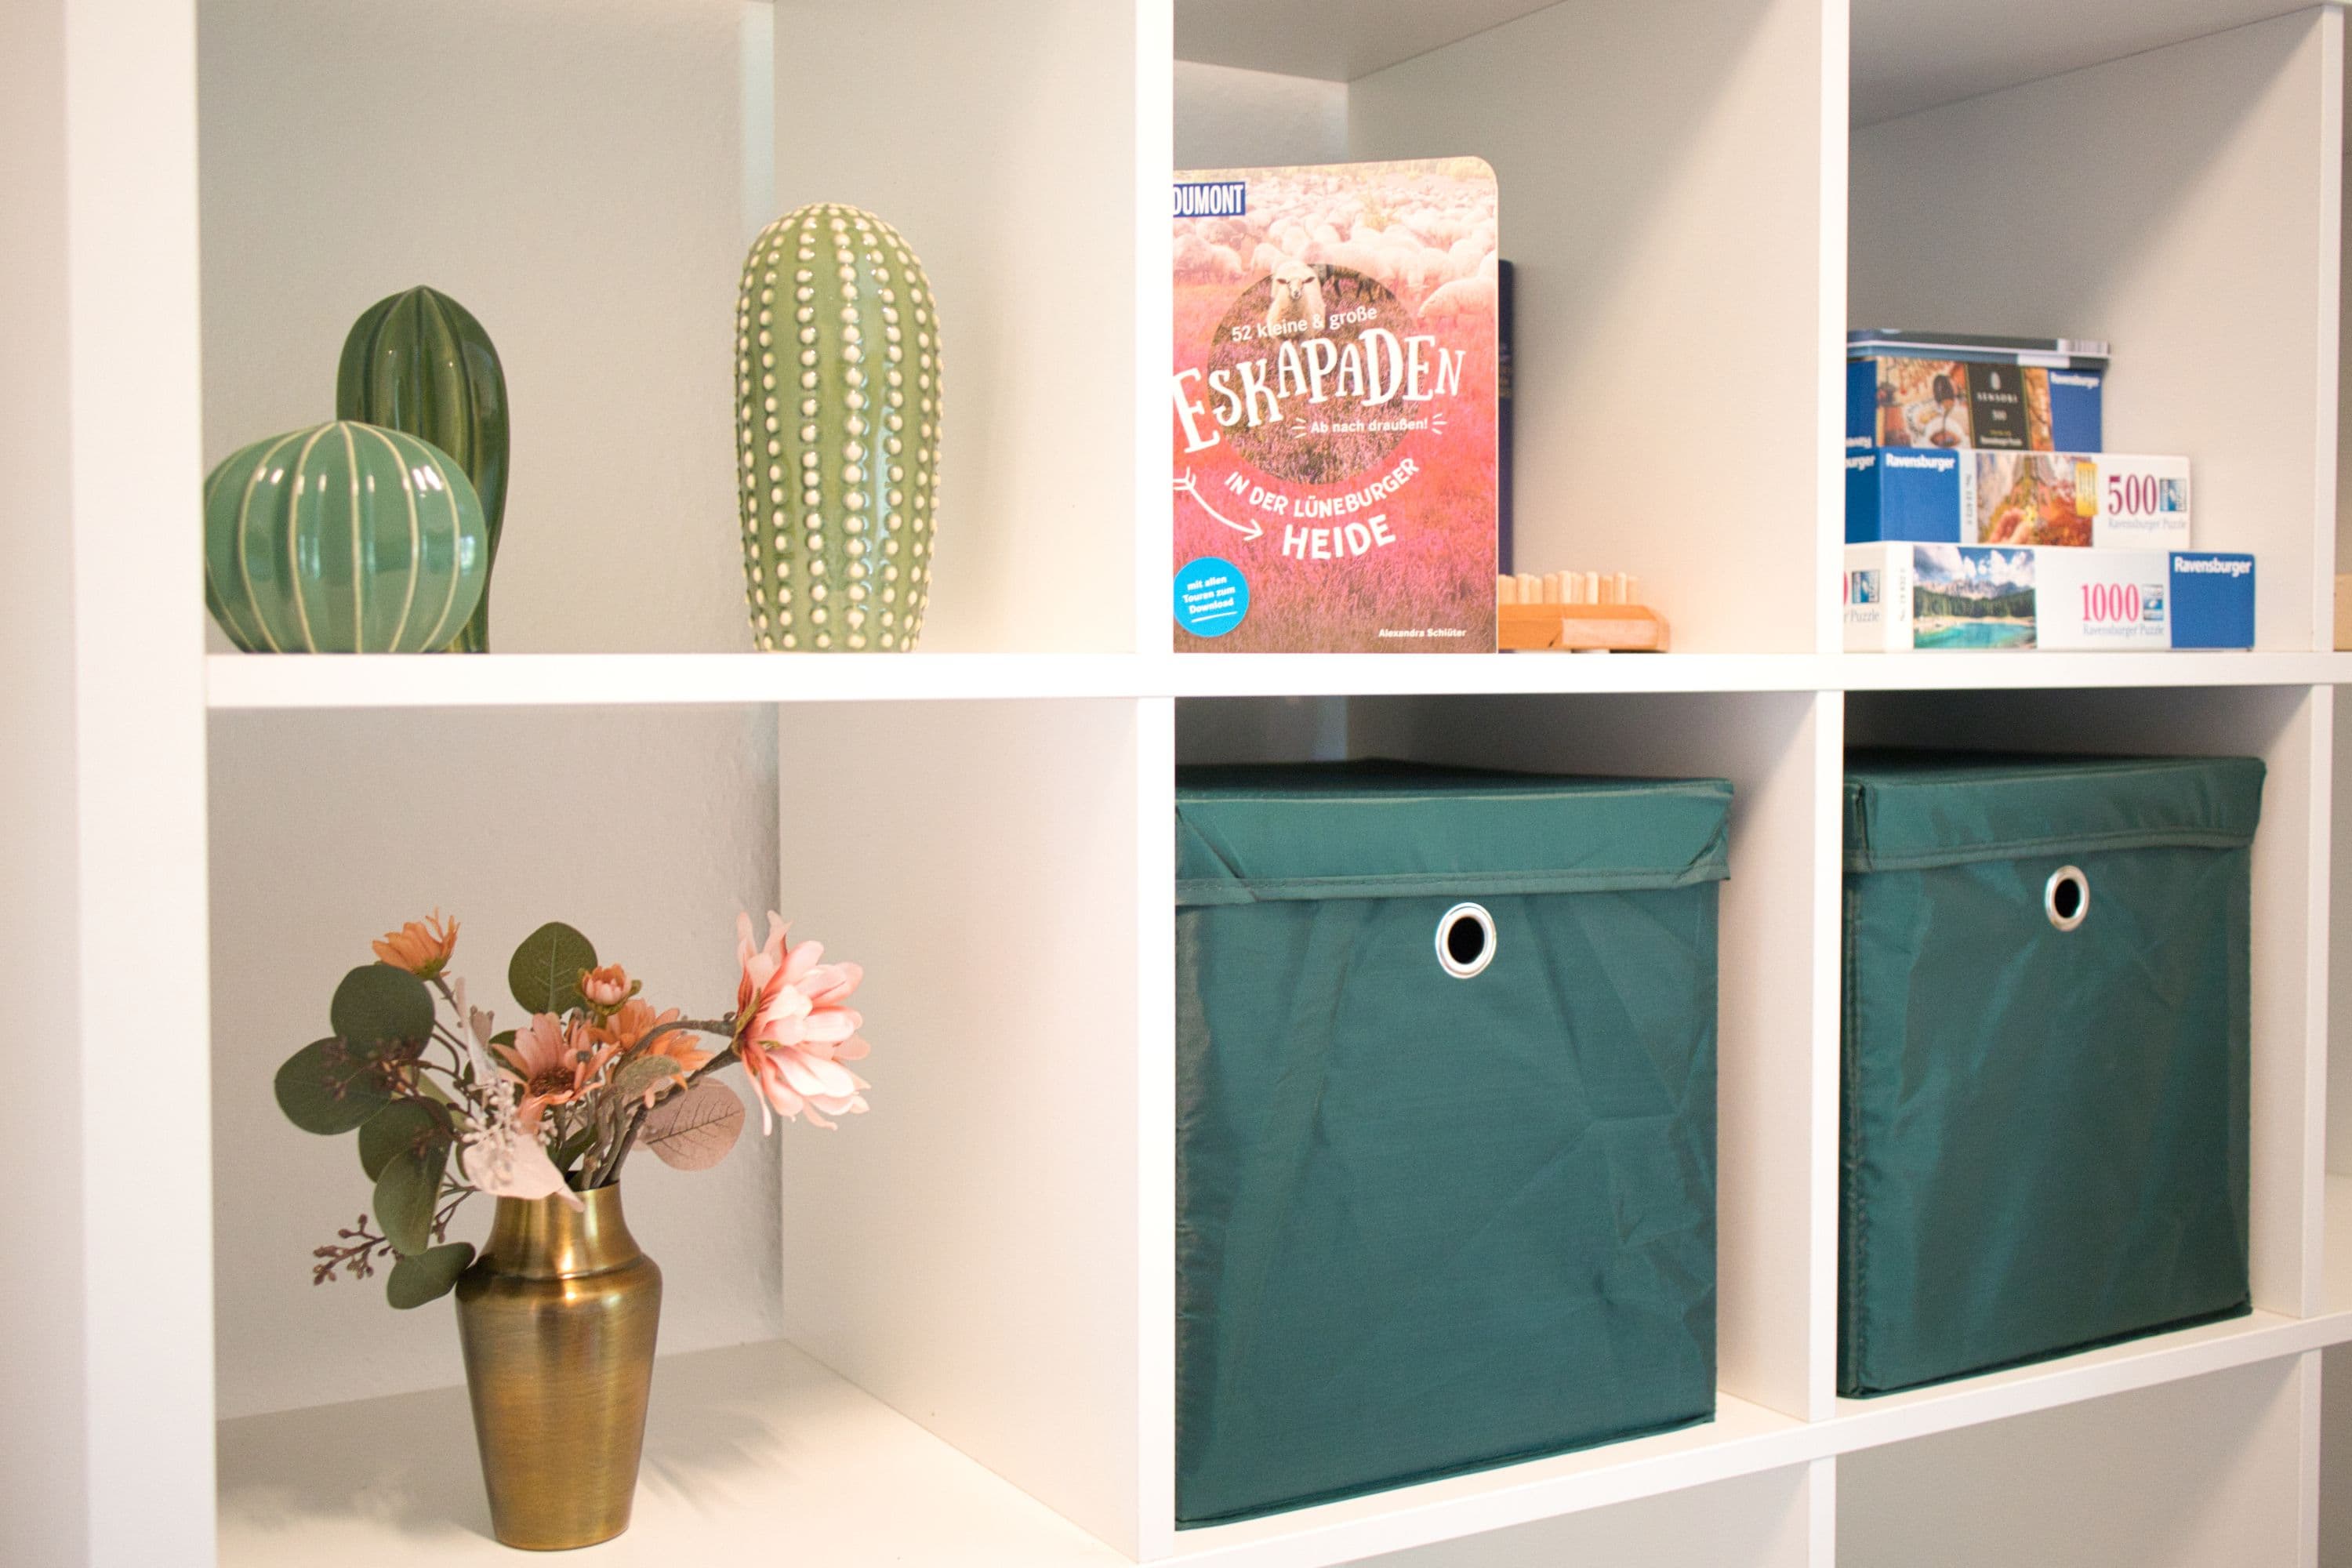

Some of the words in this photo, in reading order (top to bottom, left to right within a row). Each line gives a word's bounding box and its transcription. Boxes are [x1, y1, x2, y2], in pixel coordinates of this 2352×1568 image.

[1173, 184, 1243, 215] DUMONT
[1231, 325, 1252, 342] 52
[1257, 318, 1308, 338] kleine
[1312, 313, 1325, 330] &
[1329, 306, 1377, 330] große
[1310, 420, 1329, 434] Ab
[1333, 419, 1364, 432] nach
[1369, 418, 1428, 431] draußen!
[1886, 452, 1955, 472] Ravensburger
[1224, 471, 1250, 495] IN
[1249, 486, 1289, 515] DER
[1294, 458, 1420, 518] LÜNEBURGER
[2108, 474, 2157, 515] 500
[1282, 514, 1396, 560] HEIDE
[2174, 556, 2252, 578] Ravensburger
[1187, 579, 1203, 590] mit
[1204, 576, 1227, 587] allen
[1182, 591, 1215, 604] Touren
[1216, 586, 1236, 597] zum
[1189, 597, 1235, 615] Download
[2081, 583, 2140, 622] 1000
[1378, 628, 1425, 637] Alexandra
[1427, 627, 1467, 637] Schlüter
